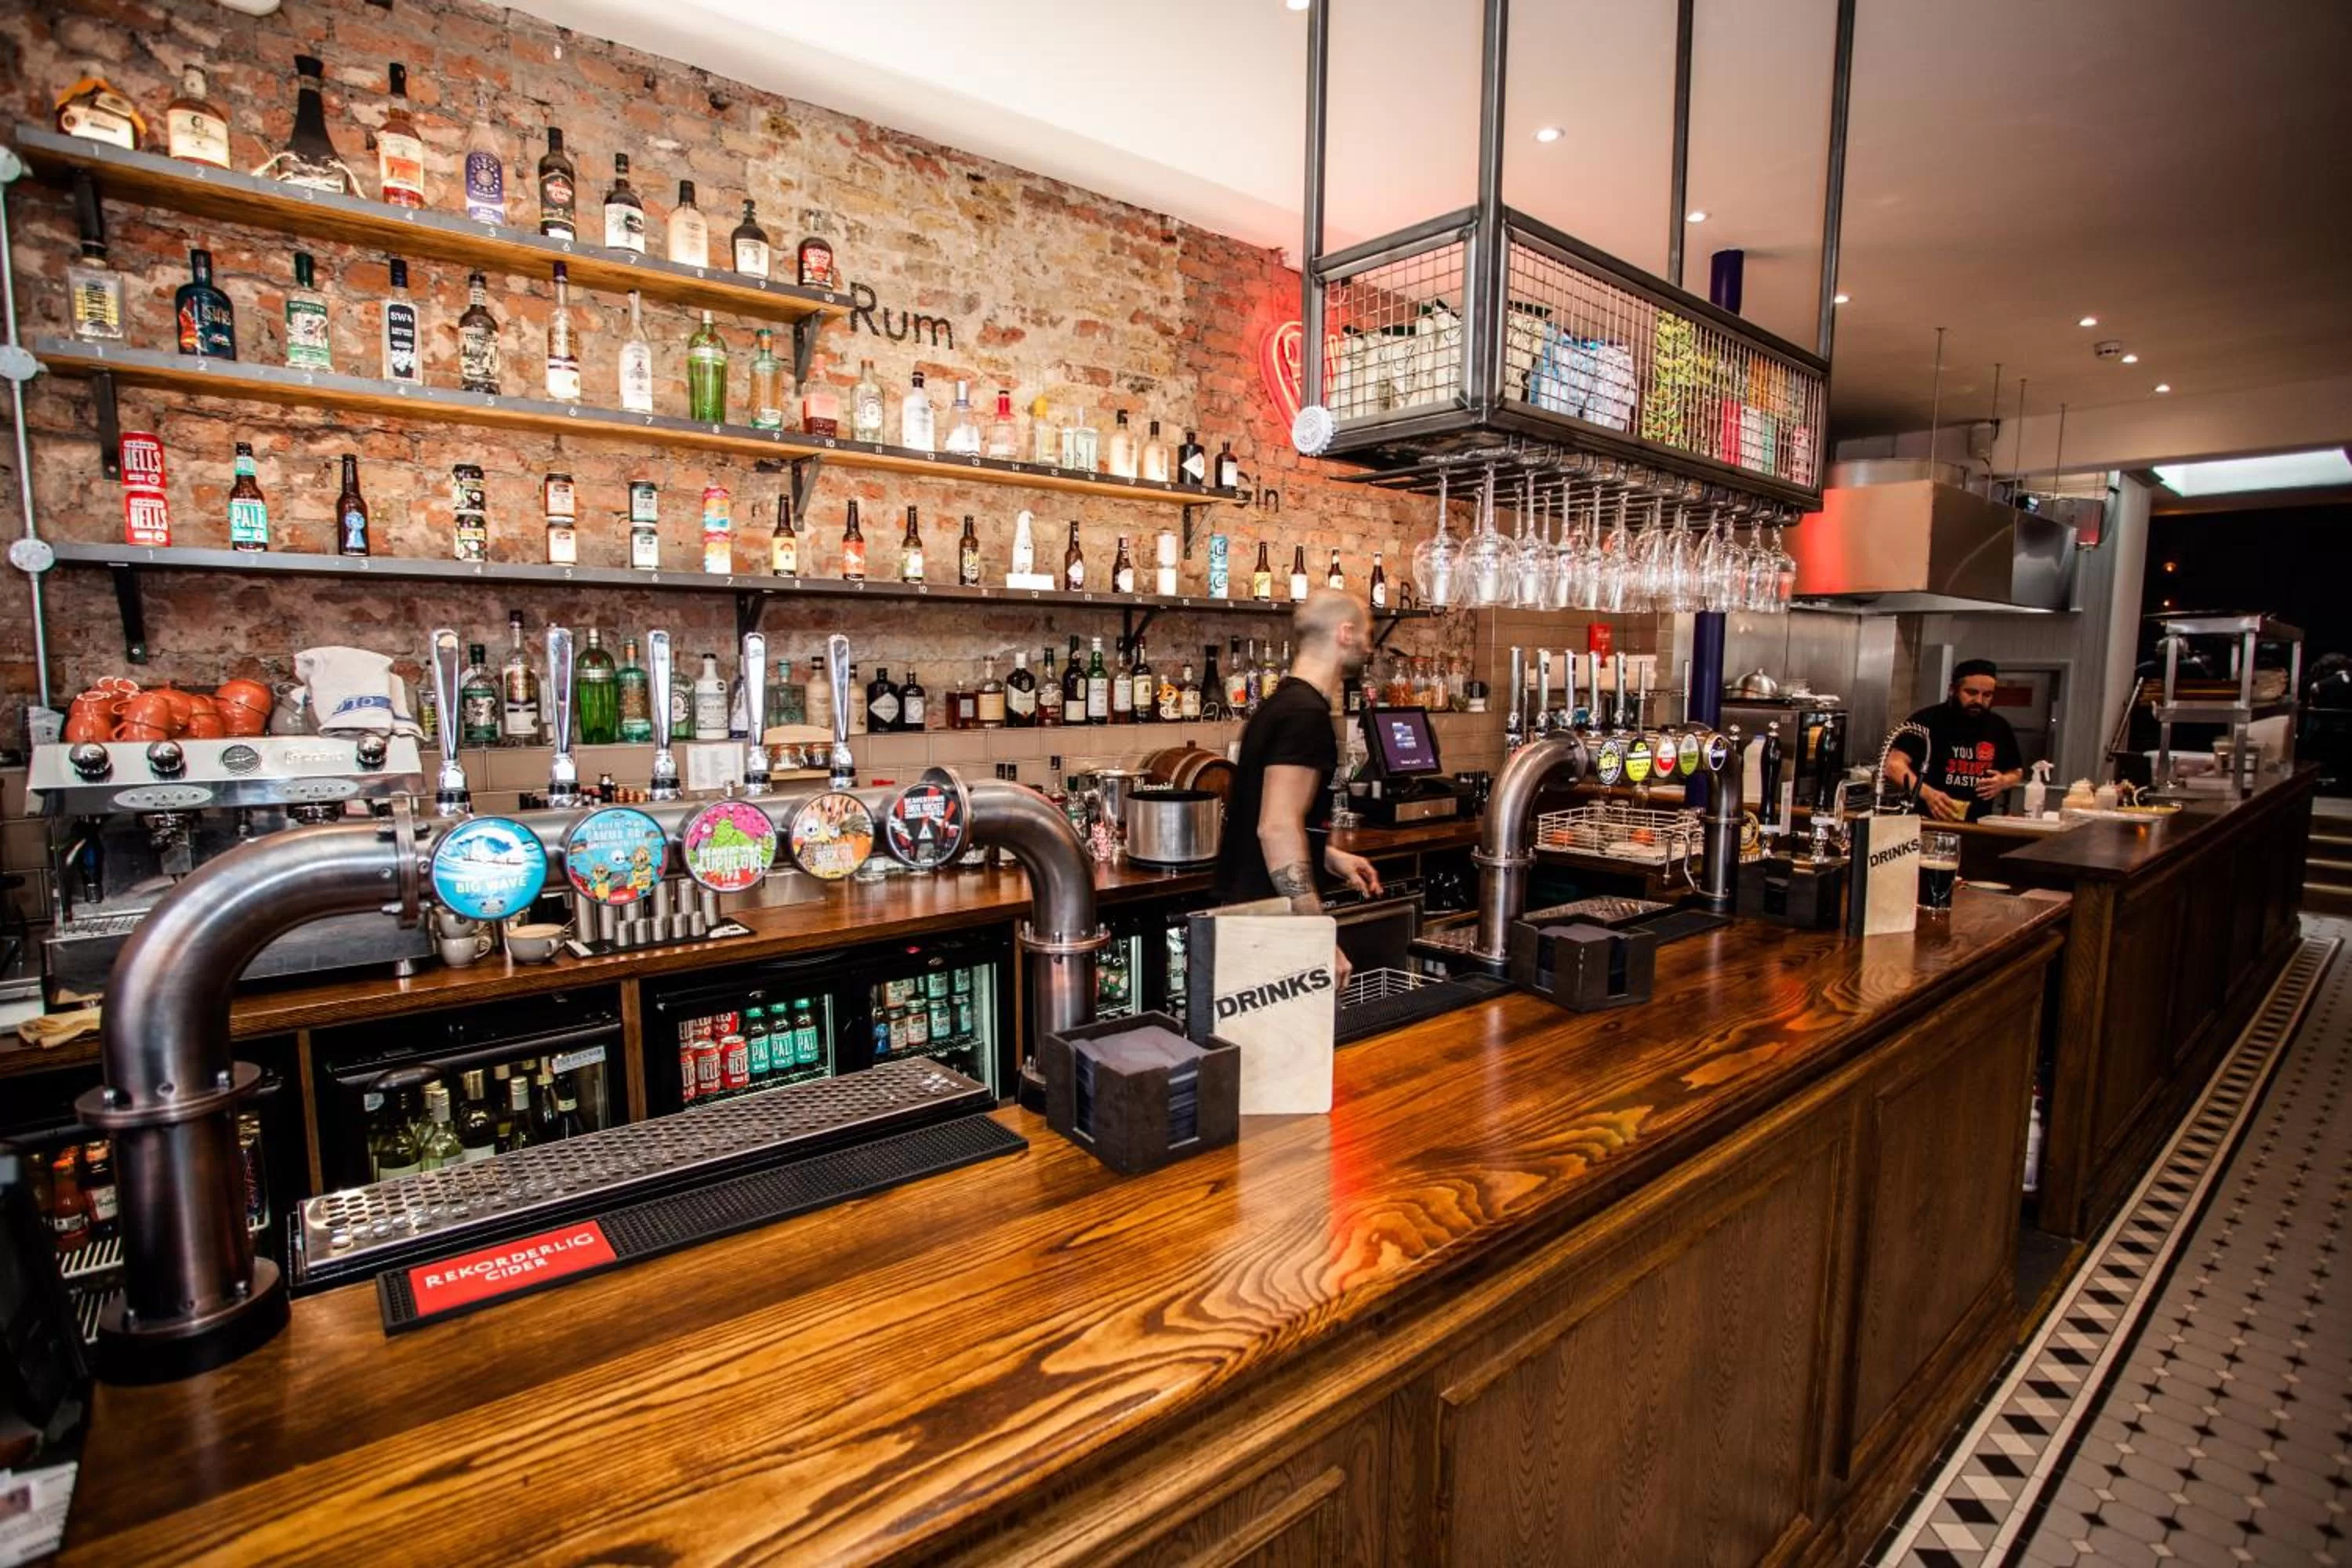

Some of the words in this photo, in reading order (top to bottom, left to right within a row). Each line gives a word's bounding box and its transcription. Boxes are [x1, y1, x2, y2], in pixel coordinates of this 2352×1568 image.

[195, 165, 205, 178] 2
[405, 210, 414, 221] 4
[562, 242, 572, 252] 6
[630, 255, 637, 265] 7
[697, 268, 704, 278] 8
[759, 280, 766, 289] 9
[850, 281, 954, 350] Rum
[197, 360, 208, 371] 2
[486, 397, 495, 406] 5
[568, 407, 577, 416] 6
[645, 416, 653, 425] 7
[713, 424, 720, 434] 8
[773, 432, 780, 441] 9
[825, 439, 835, 448] 10
[875, 445, 882, 454] 11
[123, 448, 162, 474] HELLS
[129, 506, 169, 532] HELLS
[234, 505, 265, 528] PALE
[360, 560, 368, 570] 3
[474, 564, 481, 575] 4
[564, 568, 572, 579] 5
[652, 573, 659, 583] 6
[726, 577, 734, 586] 7
[919, 585, 927, 593] 10
[1951, 746, 1974, 760] YOU
[1945, 774, 1980, 788] BAST
[1870, 838, 1920, 868] DRINKS
[456, 880, 484, 894] BIG
[485, 875, 528, 892] WAVE
[1214, 967, 1332, 1021] DRINKS
[752, 1042, 769, 1062] PAL
[424, 1233, 595, 1288] REKORDERLIG
[485, 1258, 549, 1282] CIDER
